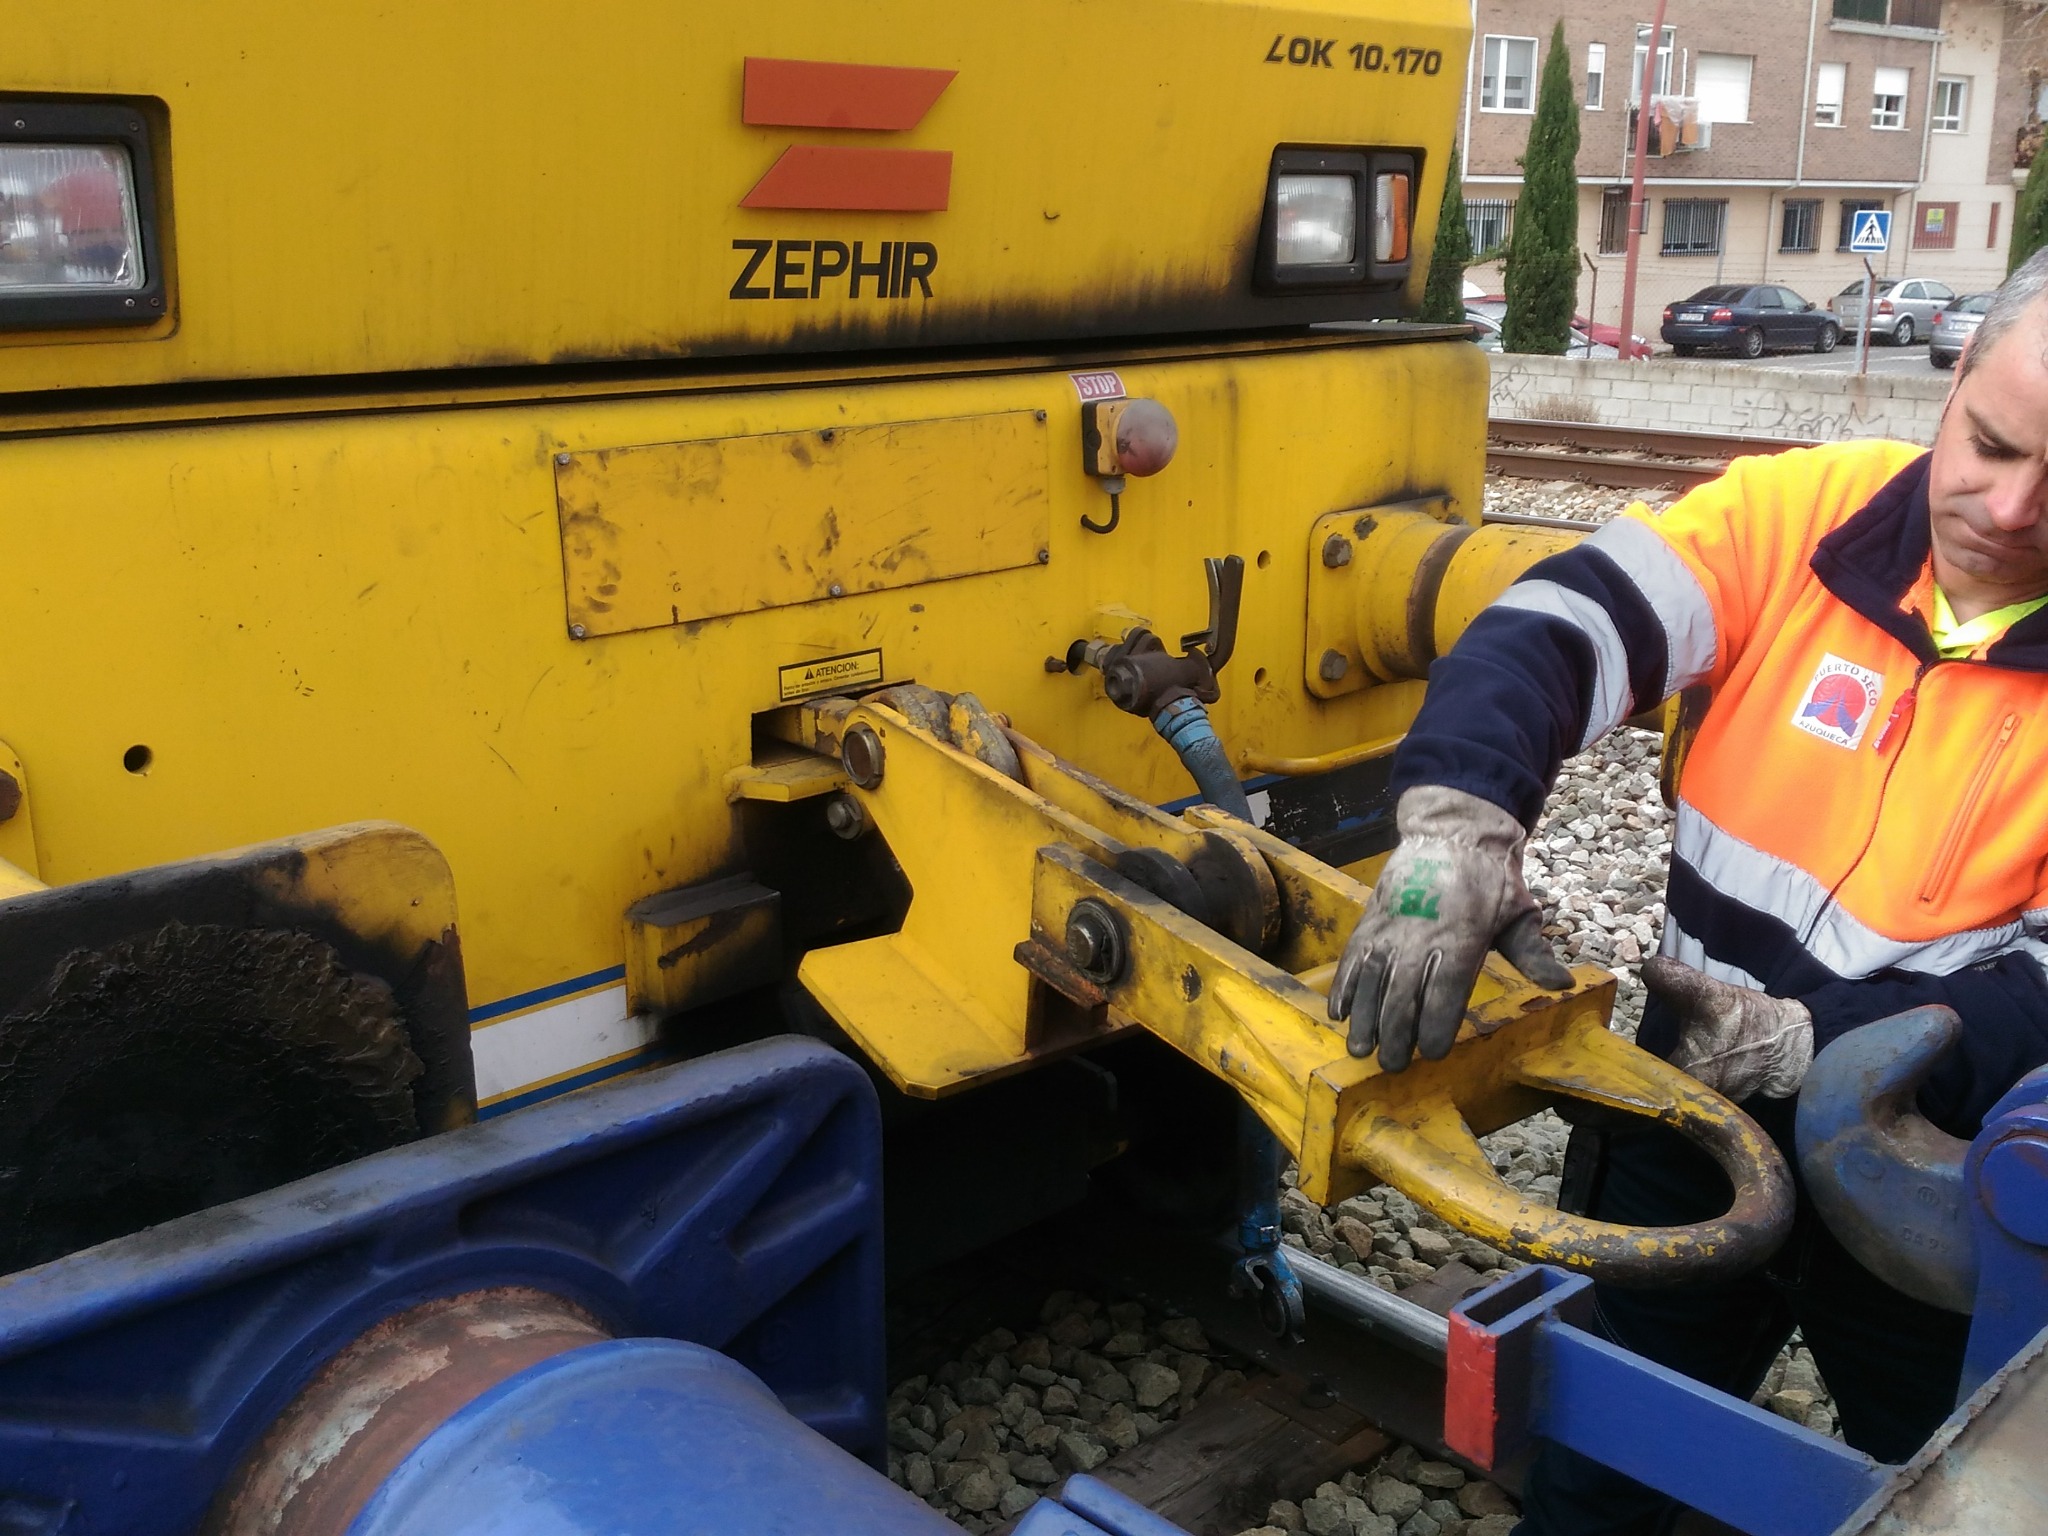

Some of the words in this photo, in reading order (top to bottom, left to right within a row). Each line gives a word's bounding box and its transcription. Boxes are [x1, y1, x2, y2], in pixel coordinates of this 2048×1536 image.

[1265, 34, 1338, 68] LOK
[1348, 42, 1443, 75] 10.170
[729, 239, 939, 300] ZEPHIR
[1078, 374, 1117, 396] STOP
[1814, 663, 1860, 682] PUERTO
[1861, 674, 1878, 707] SECO
[1799, 720, 1848, 746] AZUQUECA
